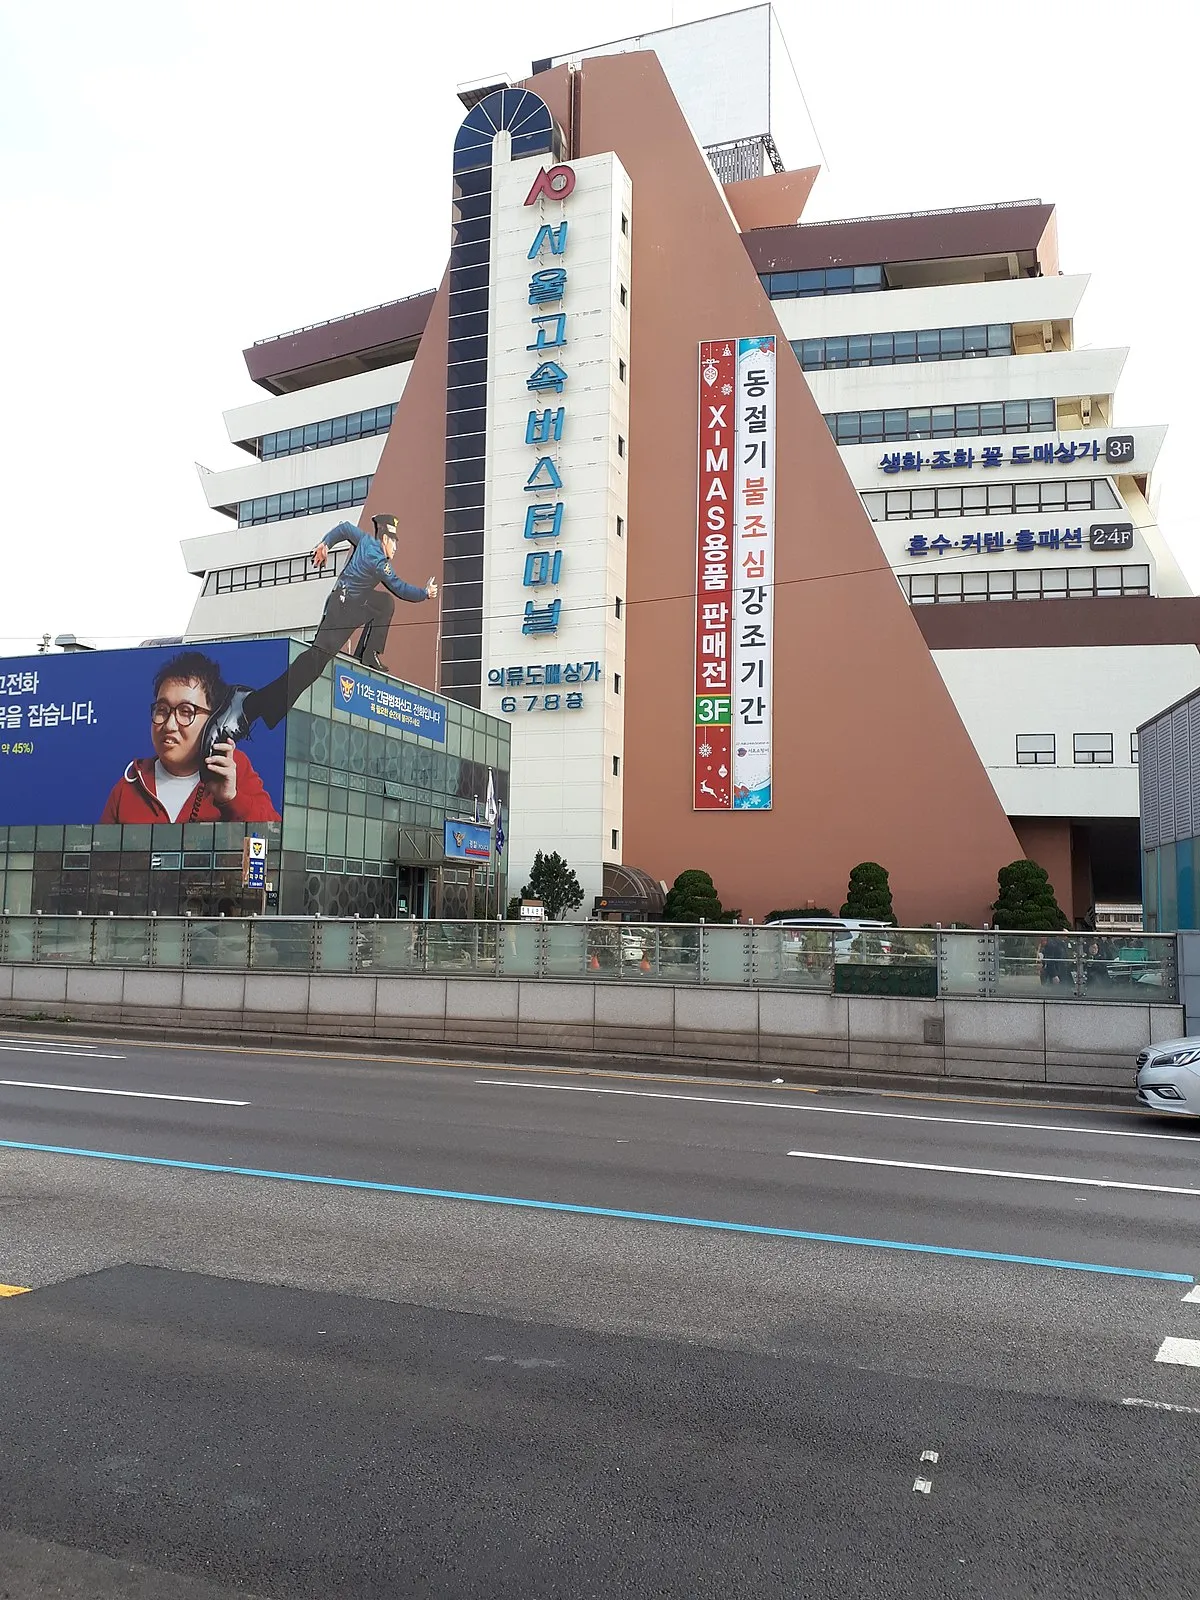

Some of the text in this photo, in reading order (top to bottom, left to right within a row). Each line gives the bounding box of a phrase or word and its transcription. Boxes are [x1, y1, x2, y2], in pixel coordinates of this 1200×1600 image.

[521, 221, 569, 635] 서울고속버스터미널
[981, 446, 1003, 468] 꽃
[1010, 440, 1100, 465] 도매상가
[1109, 441, 1132, 457] 3F
[701, 601, 729, 688] 판매전
[488, 661, 601, 687] 의류도매상가
[27, 701, 98, 727] 잡습니다.
[356, 682, 440, 724] 112는 긴급범죄신고 전화입니다
[698, 699, 730, 722] 3F
